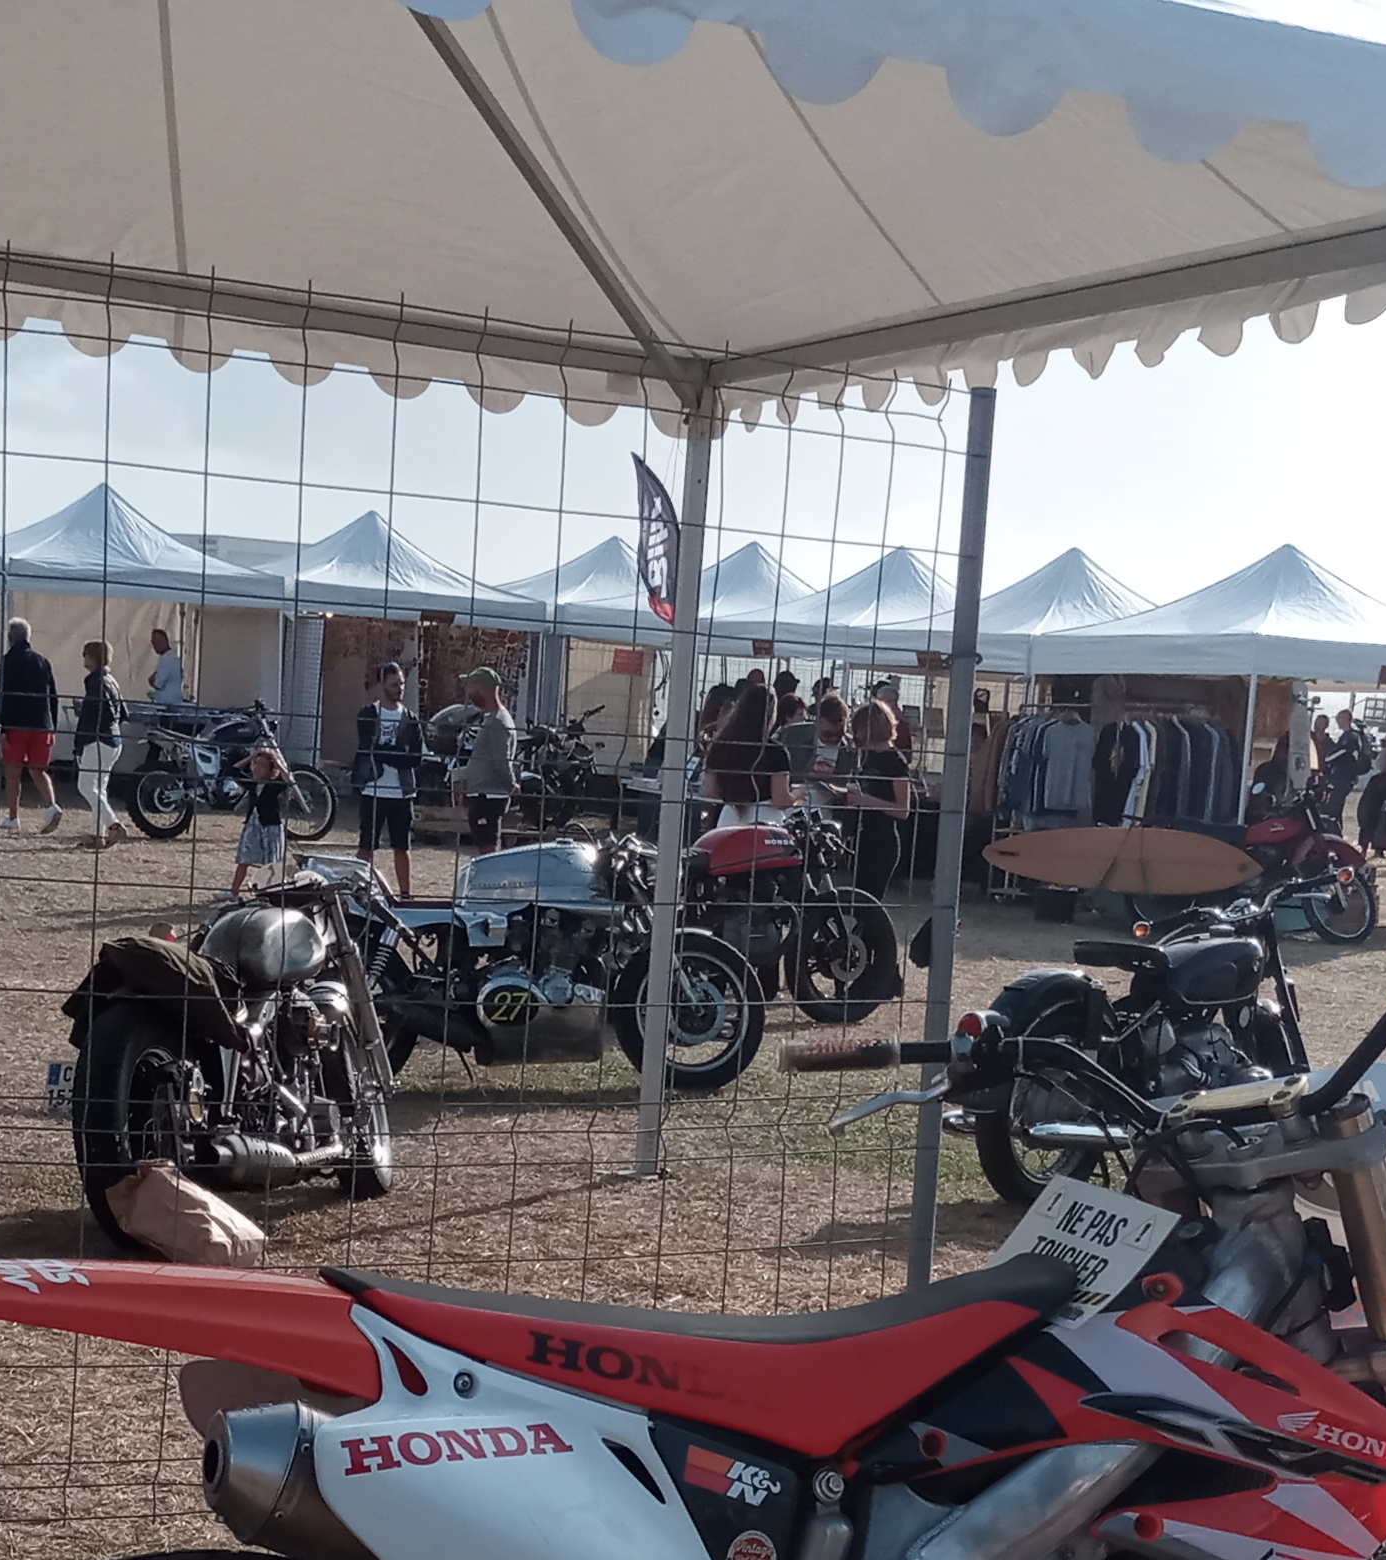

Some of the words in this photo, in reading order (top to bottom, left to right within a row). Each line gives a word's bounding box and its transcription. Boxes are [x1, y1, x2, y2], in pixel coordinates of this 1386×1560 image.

[491, 991, 529, 1021] 27
[63, 1065, 74, 1082] C
[1056, 1201, 1094, 1236] NE
[1080, 1209, 1129, 1248] PAS
[340, 1422, 574, 1477] HONDA
